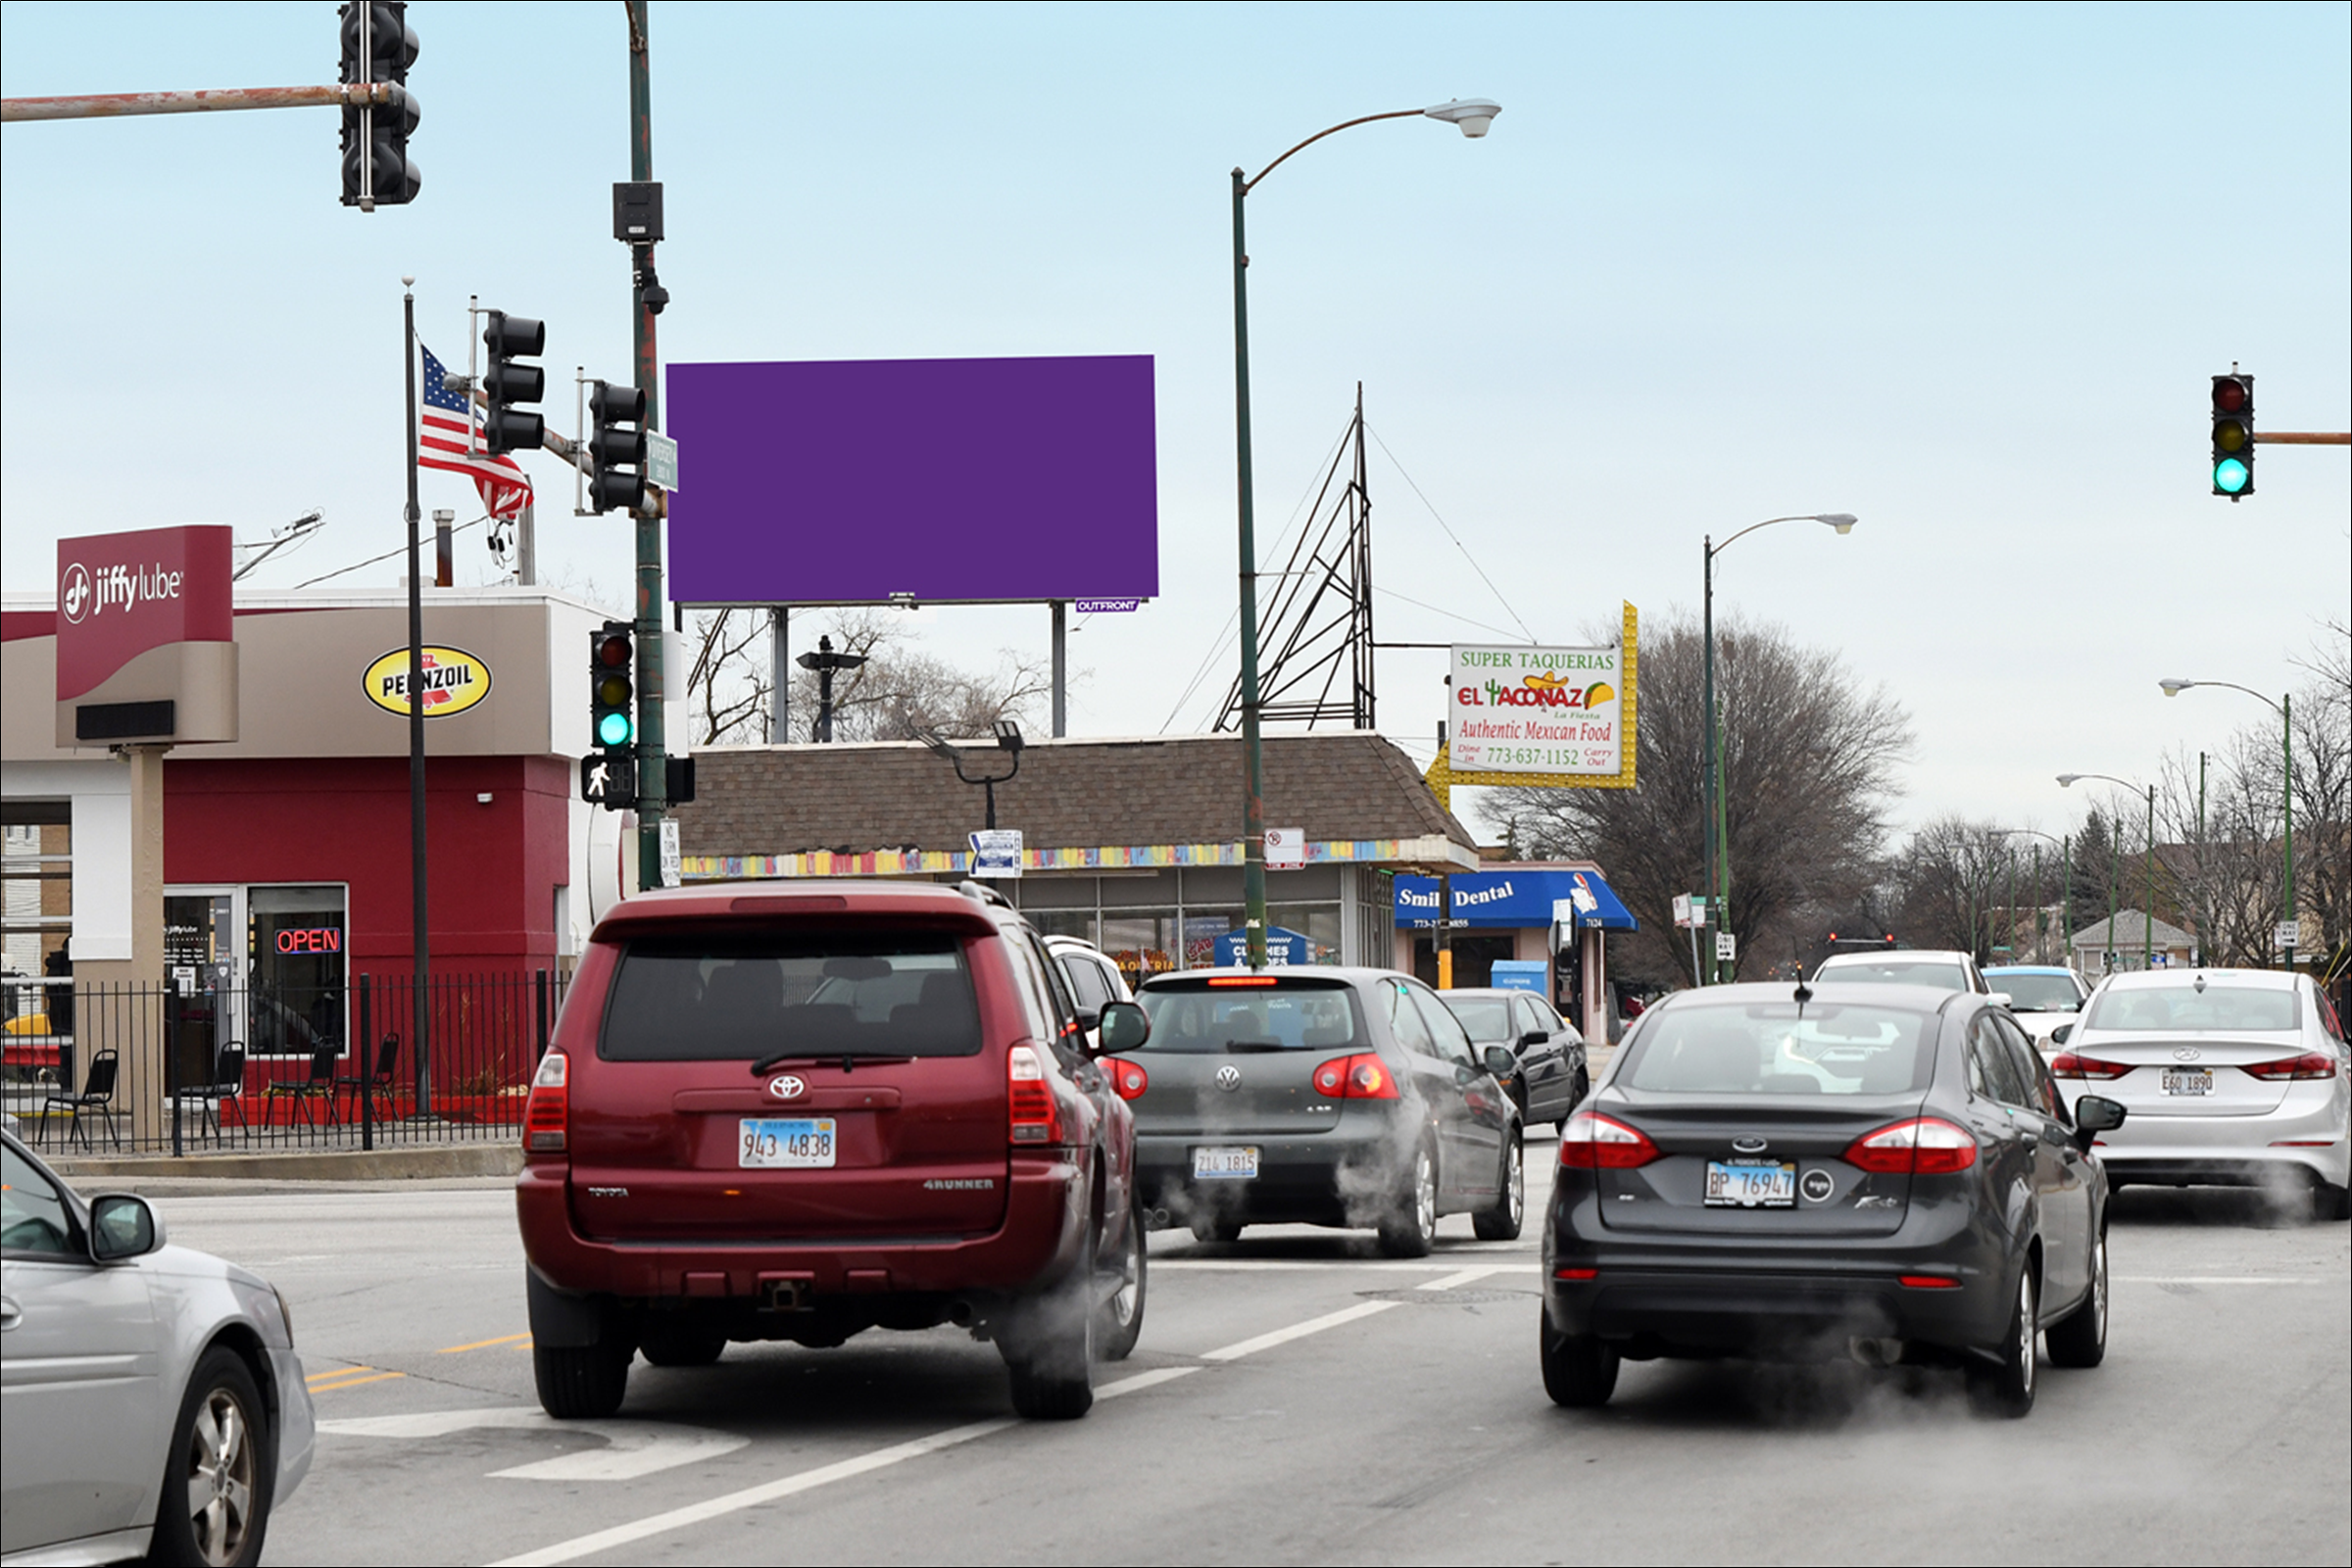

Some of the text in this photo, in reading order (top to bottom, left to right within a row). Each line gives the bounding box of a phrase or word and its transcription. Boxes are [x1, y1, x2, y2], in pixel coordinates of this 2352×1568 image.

[1078, 601, 1137, 611] OUTFRONT
[1460, 652, 1614, 671] SUPER TAQUERIAS
[1457, 687, 1484, 706] EL
[1553, 710, 1601, 720] La Fiesta
[1459, 719, 1612, 742] Authentic Mexican Food
[1457, 744, 1481, 754] Dine
[1487, 747, 1579, 767] 773-637-1152
[1584, 747, 1614, 759] Carry
[1464, 753, 1475, 762] in
[1587, 757, 1606, 766] Out
[1398, 881, 1514, 907] Smil Dental
[277, 929, 338, 953] OPEN
[2187, 1076, 2213, 1090] 1890
[745, 1134, 831, 1156] 943 4838
[1226, 1155, 1255, 1171] 1815
[923, 1179, 994, 1190] 4RUNNER
[1709, 1173, 1730, 1195] BP
[1740, 1173, 1792, 1195] 76947
